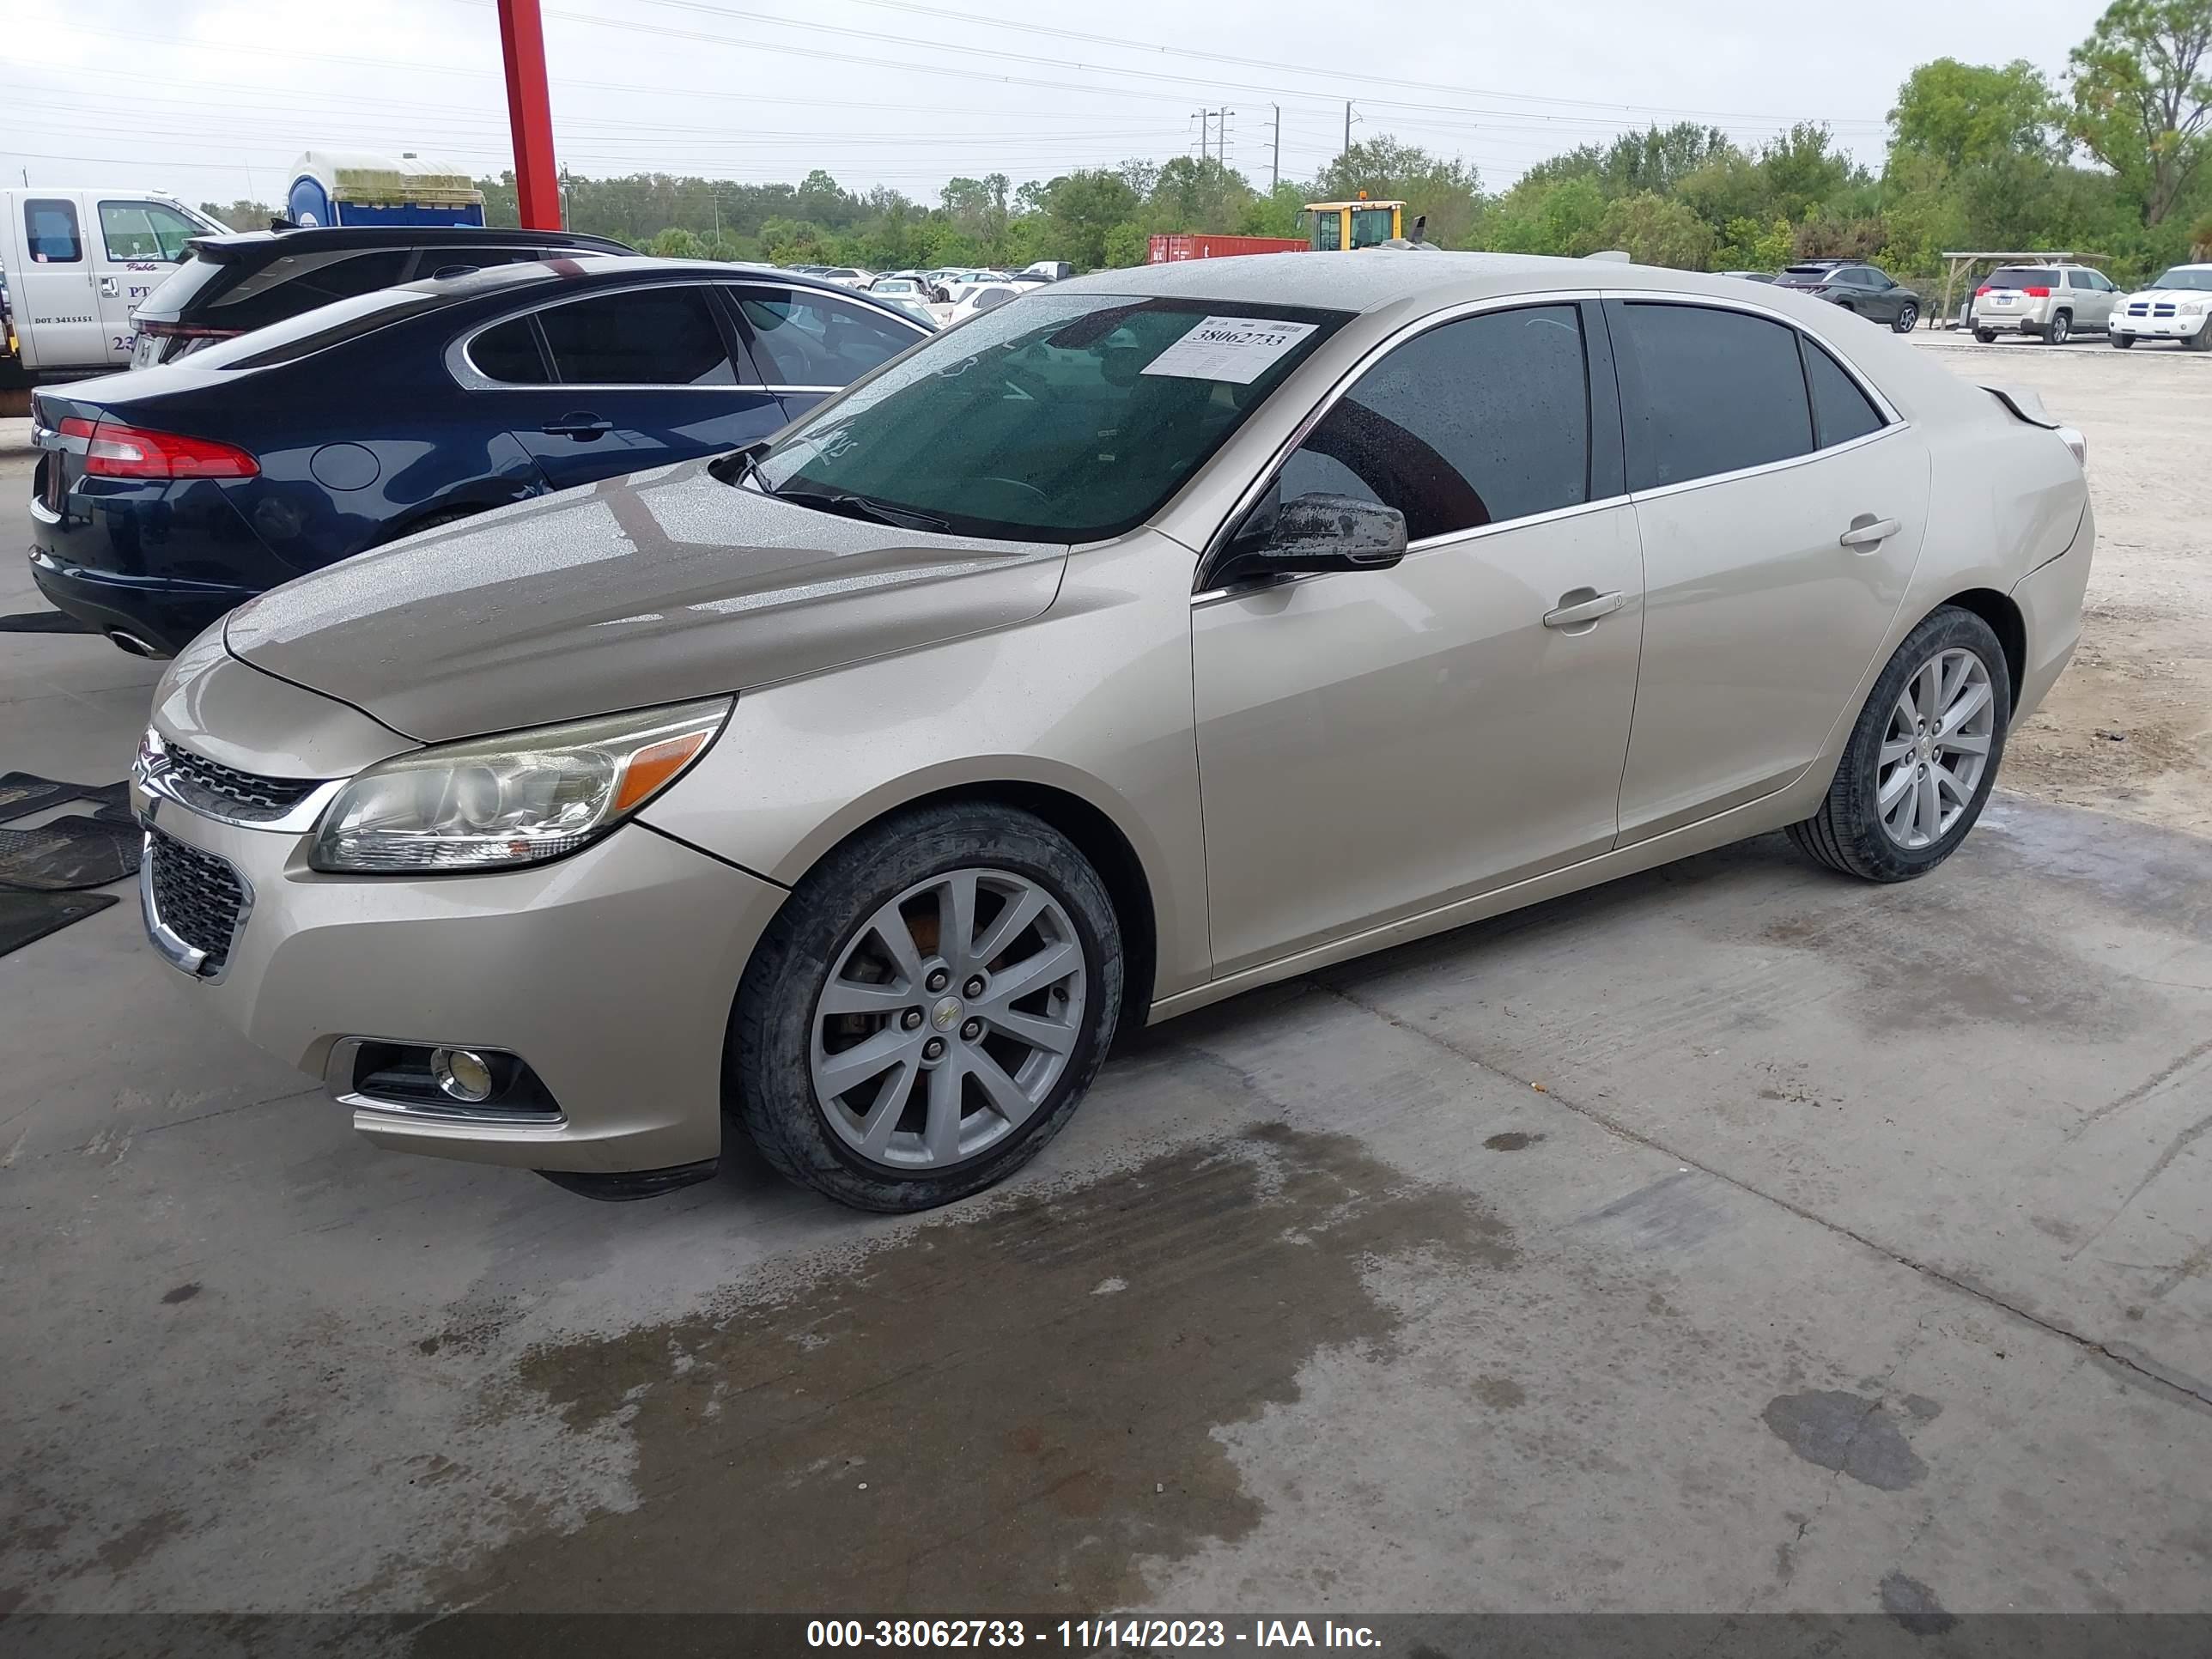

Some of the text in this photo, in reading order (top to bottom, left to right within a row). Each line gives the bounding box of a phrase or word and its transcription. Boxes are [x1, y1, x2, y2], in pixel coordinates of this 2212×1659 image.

[125, 263, 158, 271] Pablo
[128, 286, 151, 298] PT
[55, 315, 93, 324] 3415151
[1193, 330, 1286, 347] 38062733
